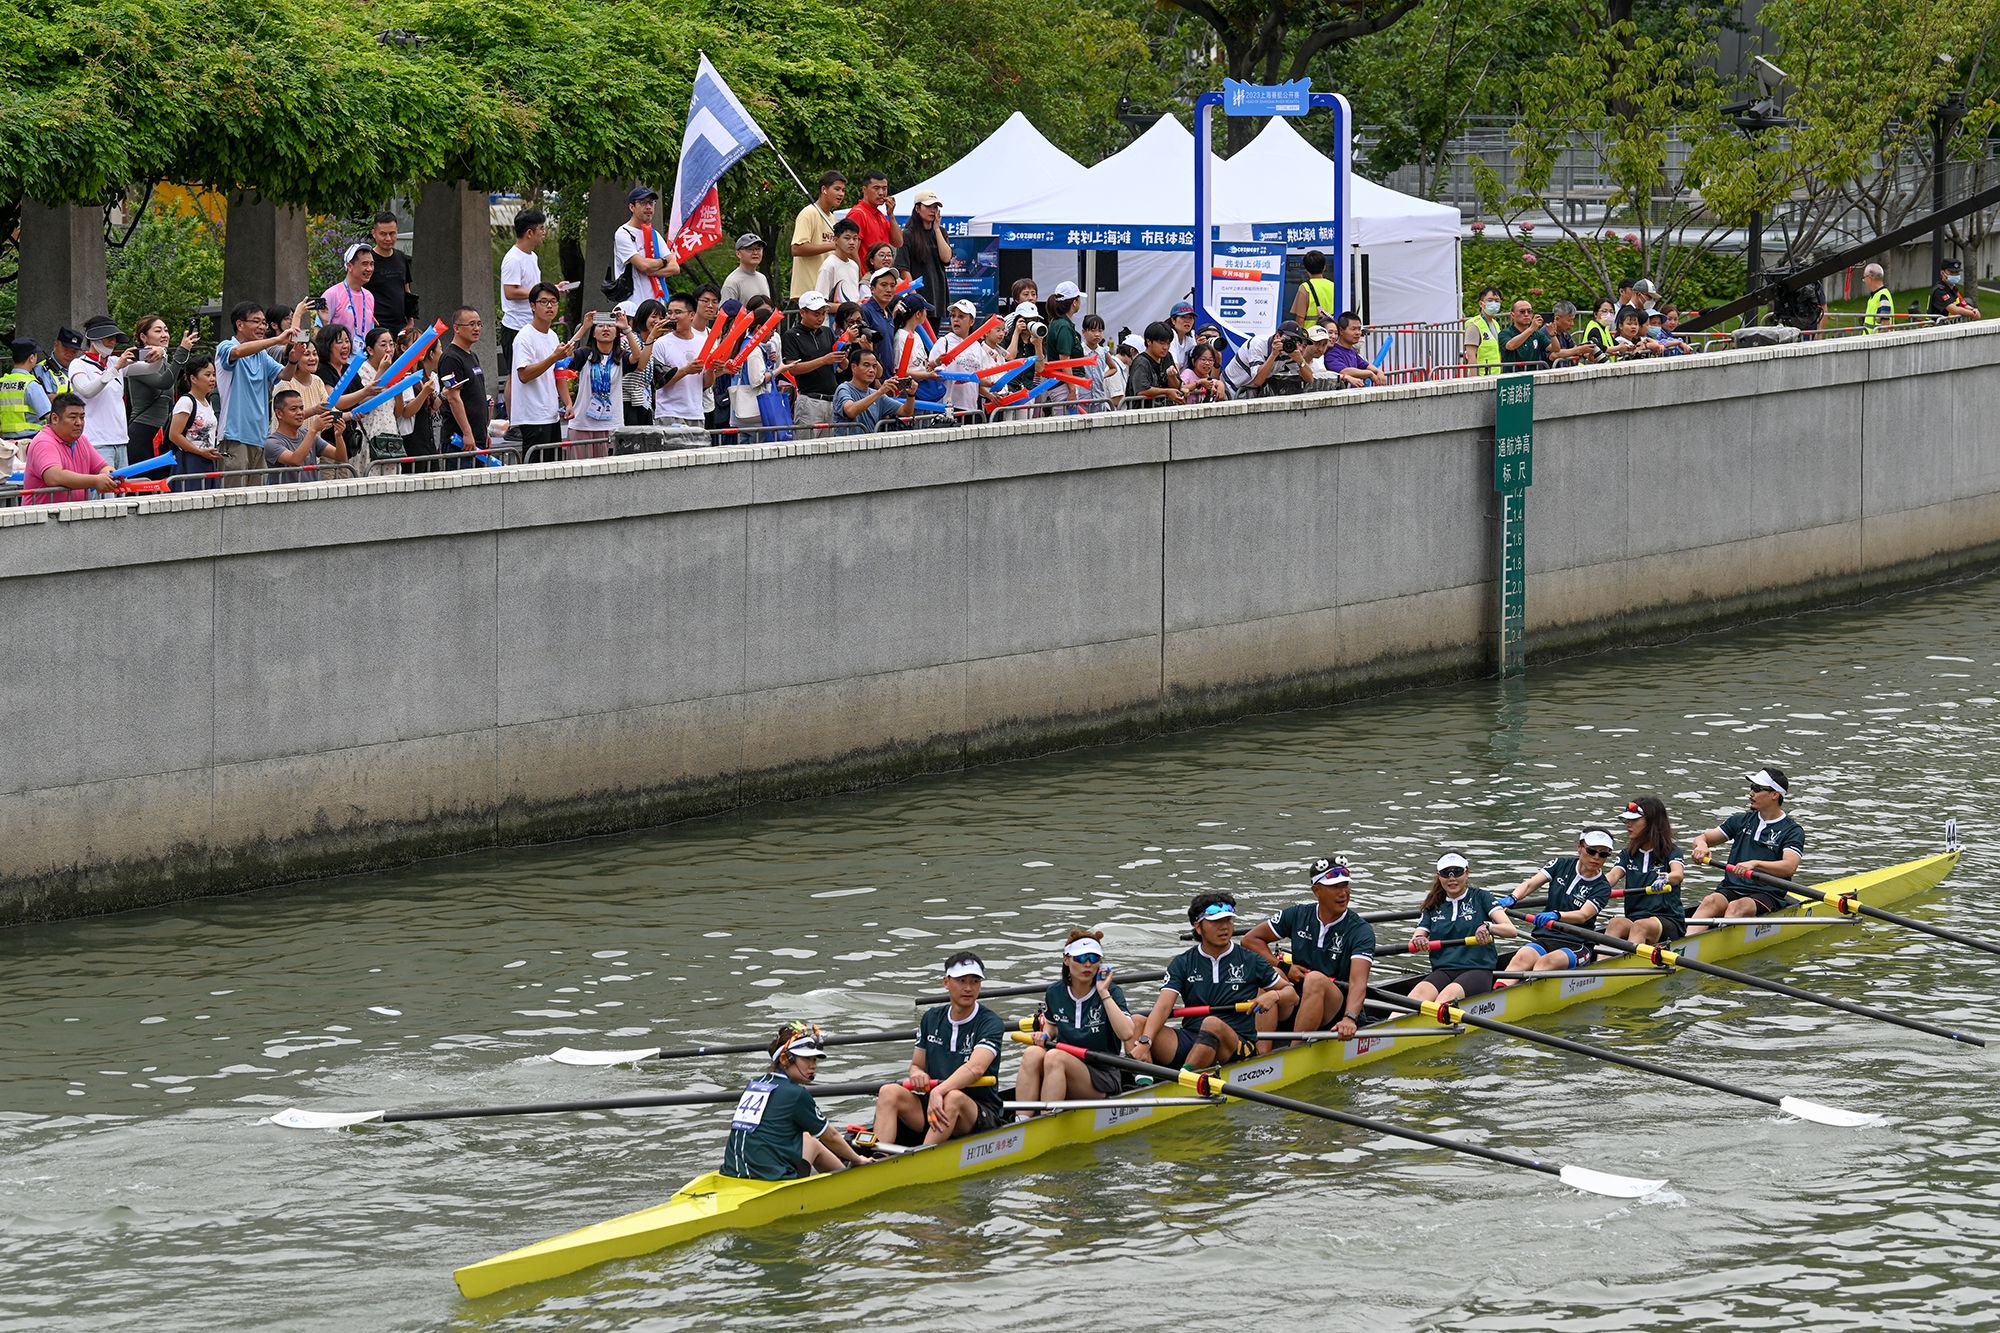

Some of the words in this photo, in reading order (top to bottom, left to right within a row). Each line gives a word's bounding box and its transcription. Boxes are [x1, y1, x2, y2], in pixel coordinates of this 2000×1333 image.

[1067, 230, 1131, 245] 共划上海滩
[1141, 230, 1196, 246] 市民体验
[1225, 260, 1271, 269] 共划上海滩
[1499, 383, 1531, 406] 乍浦路桥
[1497, 433, 1531, 458] 通航净高
[1513, 509, 1522, 521] 1.4
[1513, 533, 1522, 546] 1.6
[1512, 557, 1522, 570] 1.8
[1512, 581, 1523, 594] 2.0
[1512, 605, 1522, 618] 2.2
[1511, 630, 1522, 642] 2.4
[1947, 823, 1956, 846] 44
[1478, 1002, 1496, 1015] Hello
[1091, 1026, 1100, 1034] YX
[739, 1094, 765, 1116] 44
